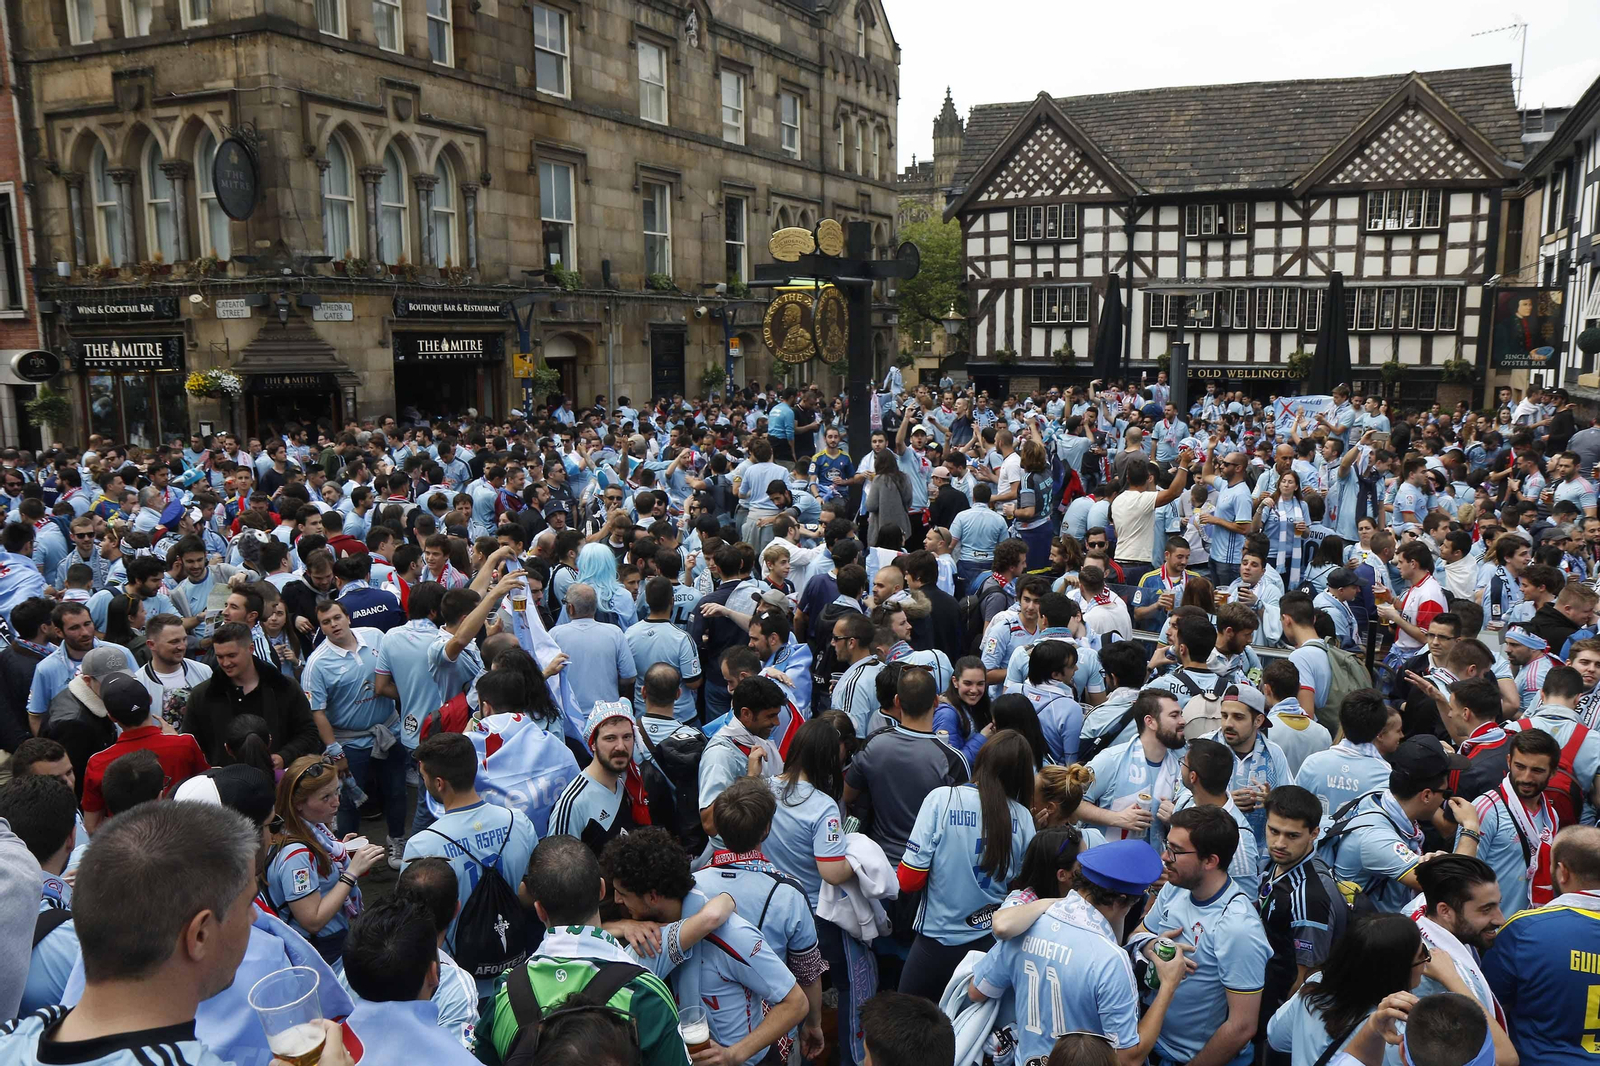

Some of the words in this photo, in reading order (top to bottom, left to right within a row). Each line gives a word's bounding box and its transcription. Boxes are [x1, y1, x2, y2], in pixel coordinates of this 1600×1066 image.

[225, 170, 245, 180] THE
[221, 180, 250, 190] MITRE
[216, 300, 245, 308] CATEATO
[782, 294, 803, 302] THE
[77, 306, 97, 314] WINE
[98, 305, 104, 314] &
[104, 304, 139, 314] COCKTAIL
[140, 303, 154, 312] BAR
[408, 303, 442, 312] BOUTIQUE
[444, 303, 456, 311] BAR
[463, 304, 500, 312] RESTAURANT
[763, 328, 774, 347] OLD
[83, 343, 109, 357] THE
[121, 342, 163, 357] MITRE
[417, 340, 440, 352] THE
[450, 340, 483, 352] MITRE
[776, 345, 816, 362] WELLING
[1198, 369, 1221, 378] OLD
[1227, 369, 1305, 378] WELLINGTON
[354, 605, 388, 619] ABANCA
[1326, 774, 1359, 792] WASS
[950, 810, 976, 827] HUGO
[443, 837, 471, 858] IAGO
[475, 827, 511, 850] ASPAS
[828, 834, 839, 842] LFP
[1022, 935, 1072, 965] GUIDETTI
[1024, 959, 1067, 1039] 11
